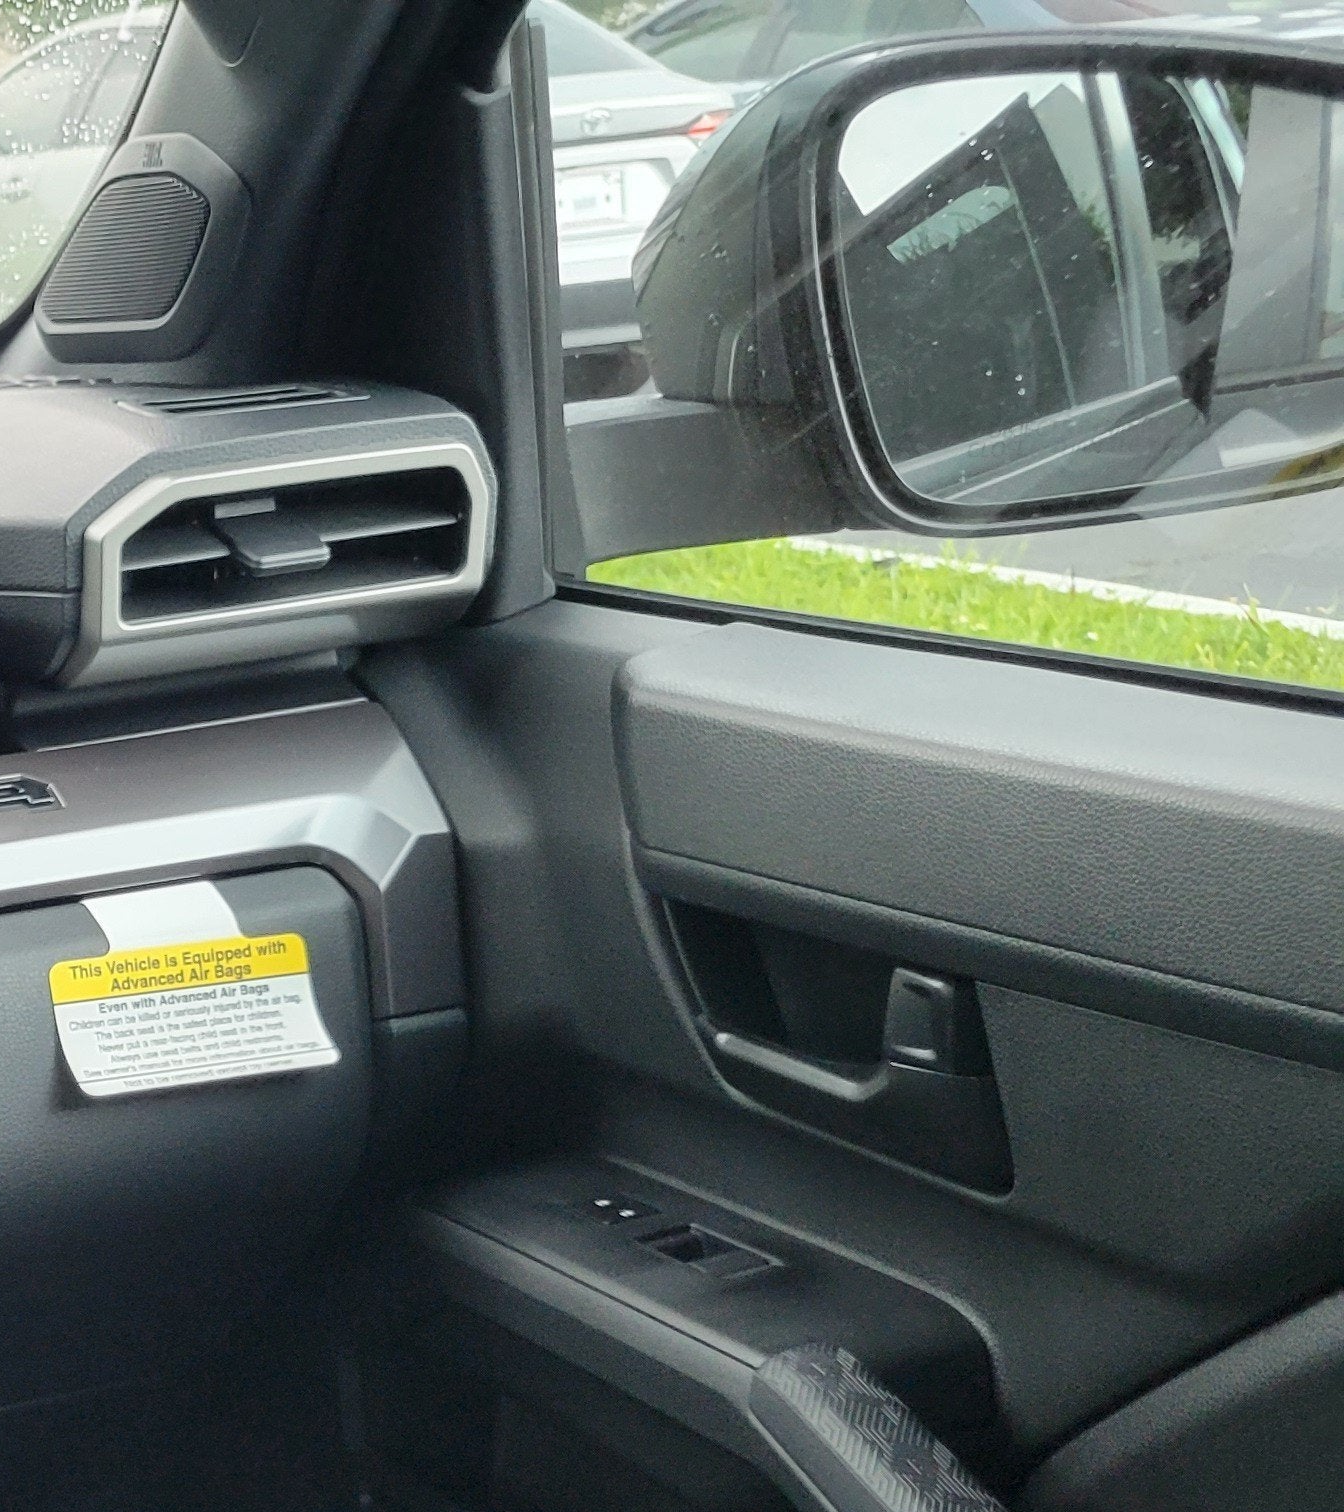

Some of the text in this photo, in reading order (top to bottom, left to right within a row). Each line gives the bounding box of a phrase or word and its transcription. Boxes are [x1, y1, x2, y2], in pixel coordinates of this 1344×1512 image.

[70, 940, 287, 980] This Vehicle is Equipped with
[111, 962, 252, 992] Advanced Air Bags
[99, 984, 270, 1013] Even with Advanced Air Bags
